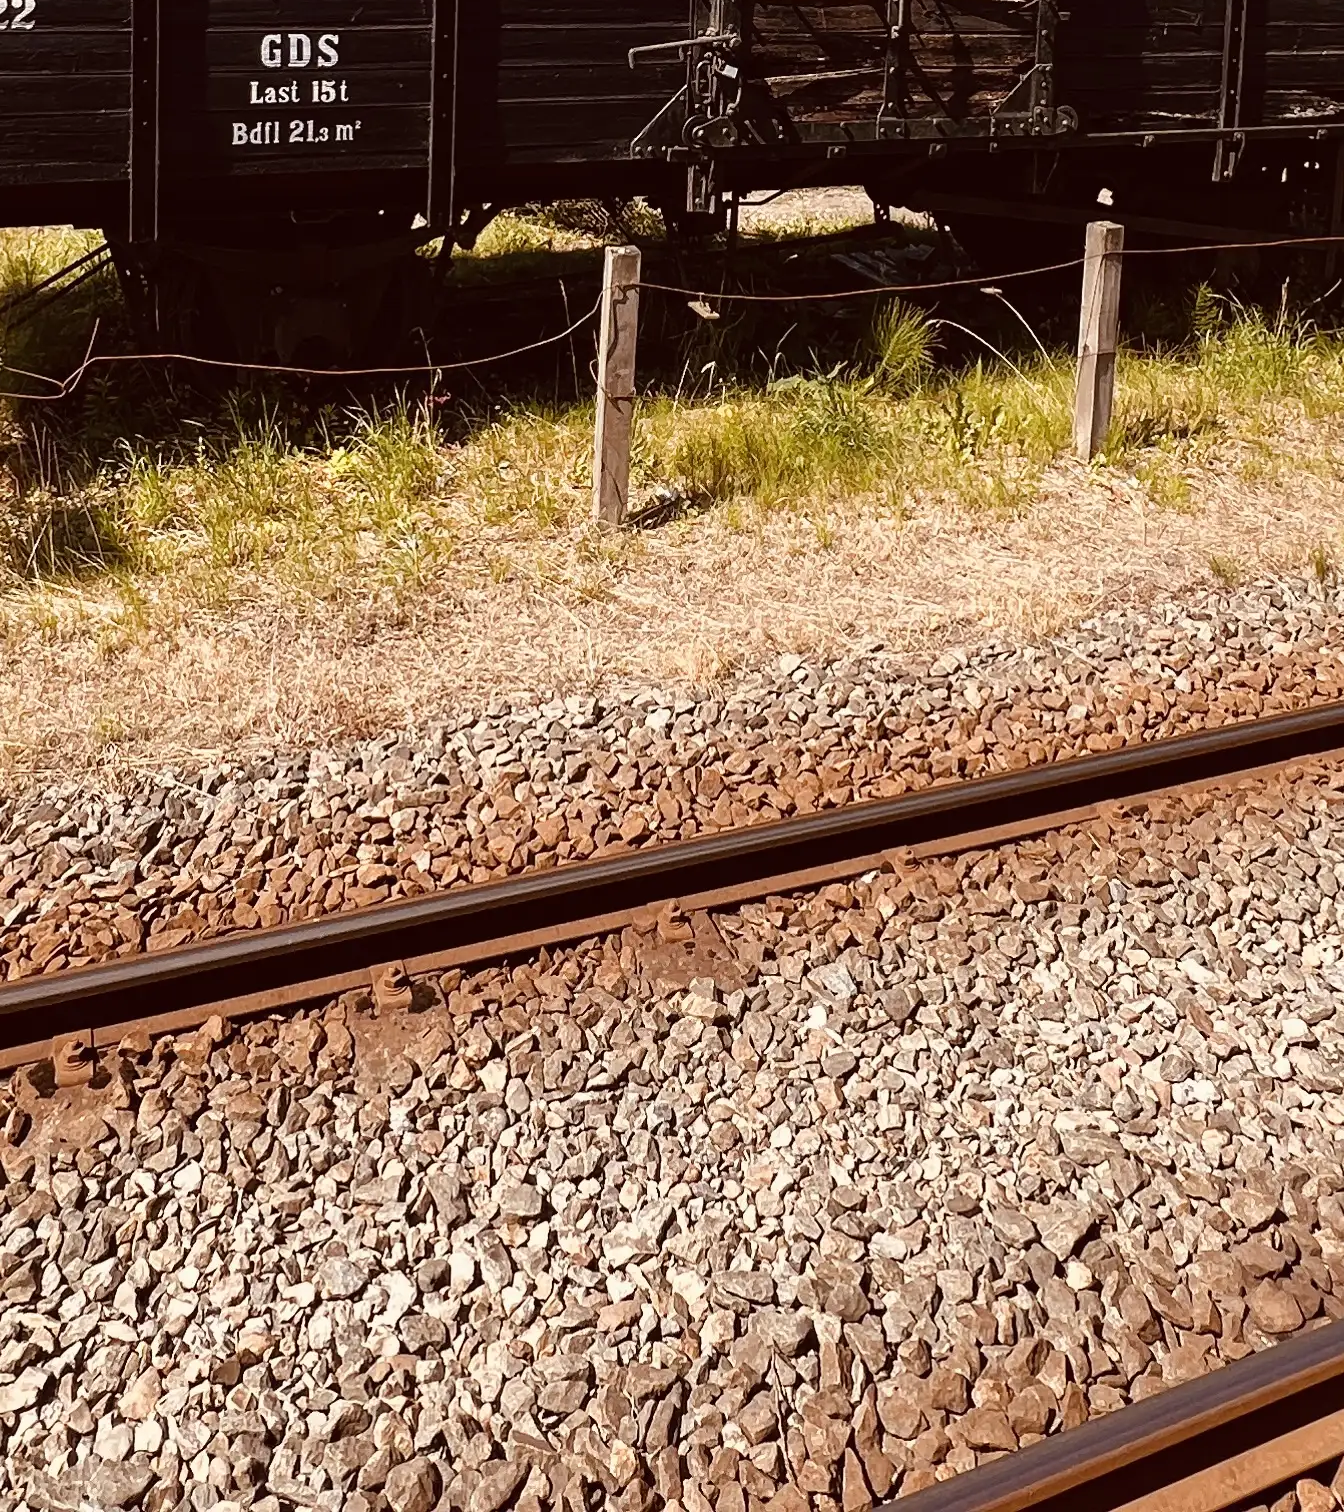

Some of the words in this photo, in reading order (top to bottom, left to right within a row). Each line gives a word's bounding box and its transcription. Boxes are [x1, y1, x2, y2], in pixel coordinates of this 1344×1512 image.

[260, 33, 339, 68] GDS
[249, 80, 301, 105] Last
[231, 121, 280, 146] Bdfl
